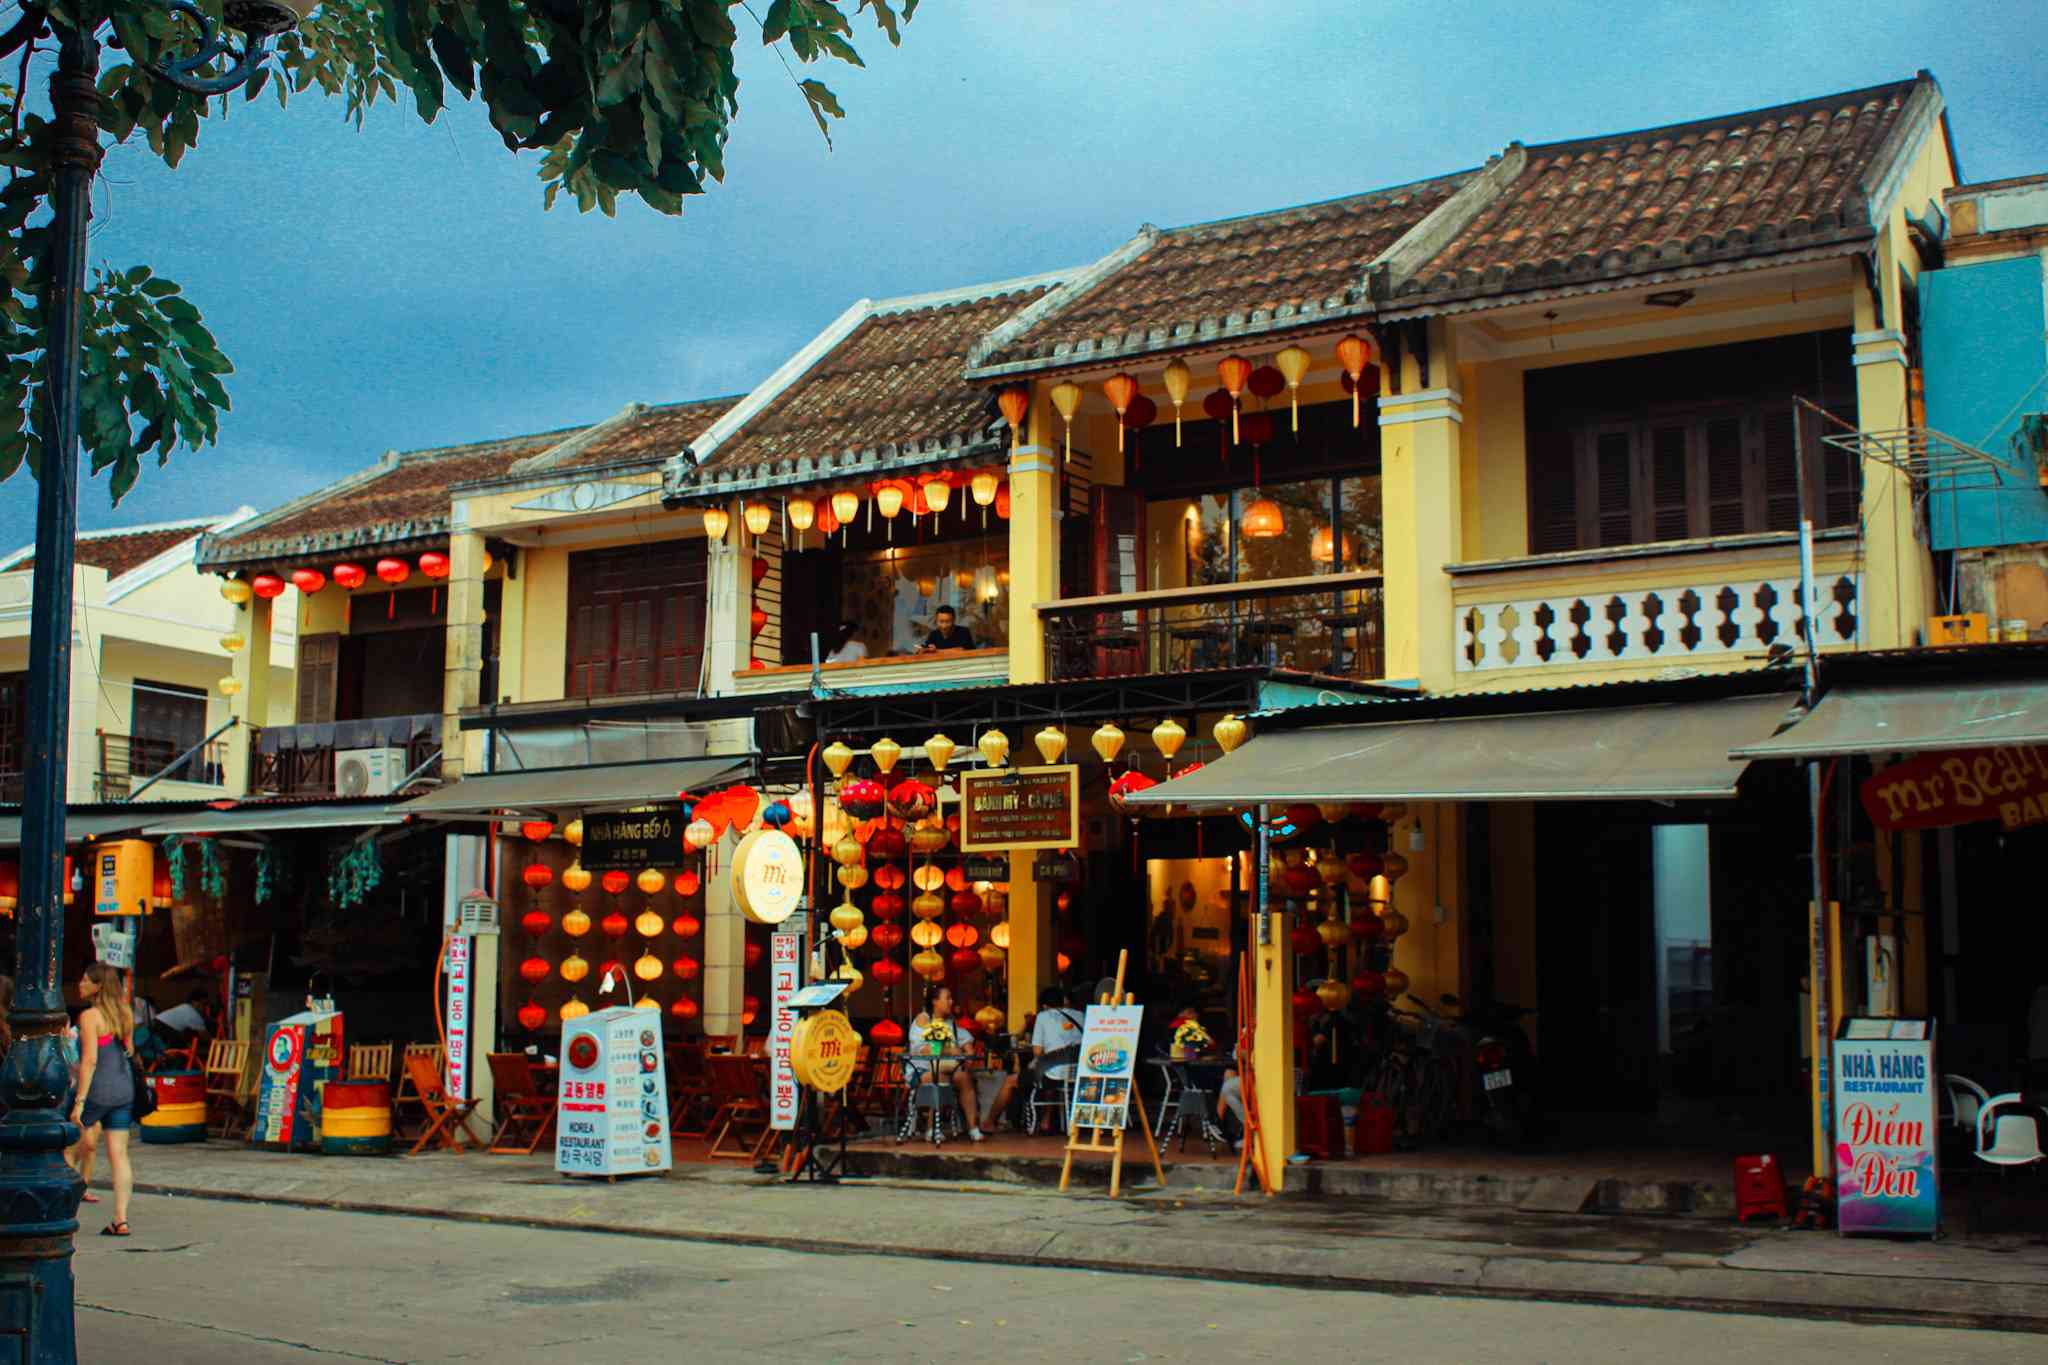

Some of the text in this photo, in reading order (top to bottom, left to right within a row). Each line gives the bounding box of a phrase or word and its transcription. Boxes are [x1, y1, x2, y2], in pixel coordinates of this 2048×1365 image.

[1842, 1049, 1925, 1080] NHÀ HÀNG
[1843, 1081, 1924, 1094] RESTAURANT
[569, 1122, 595, 1133] KOREA
[560, 1136, 606, 1150] RESTAURANT
[560, 1150, 603, 1167] 한국식당
